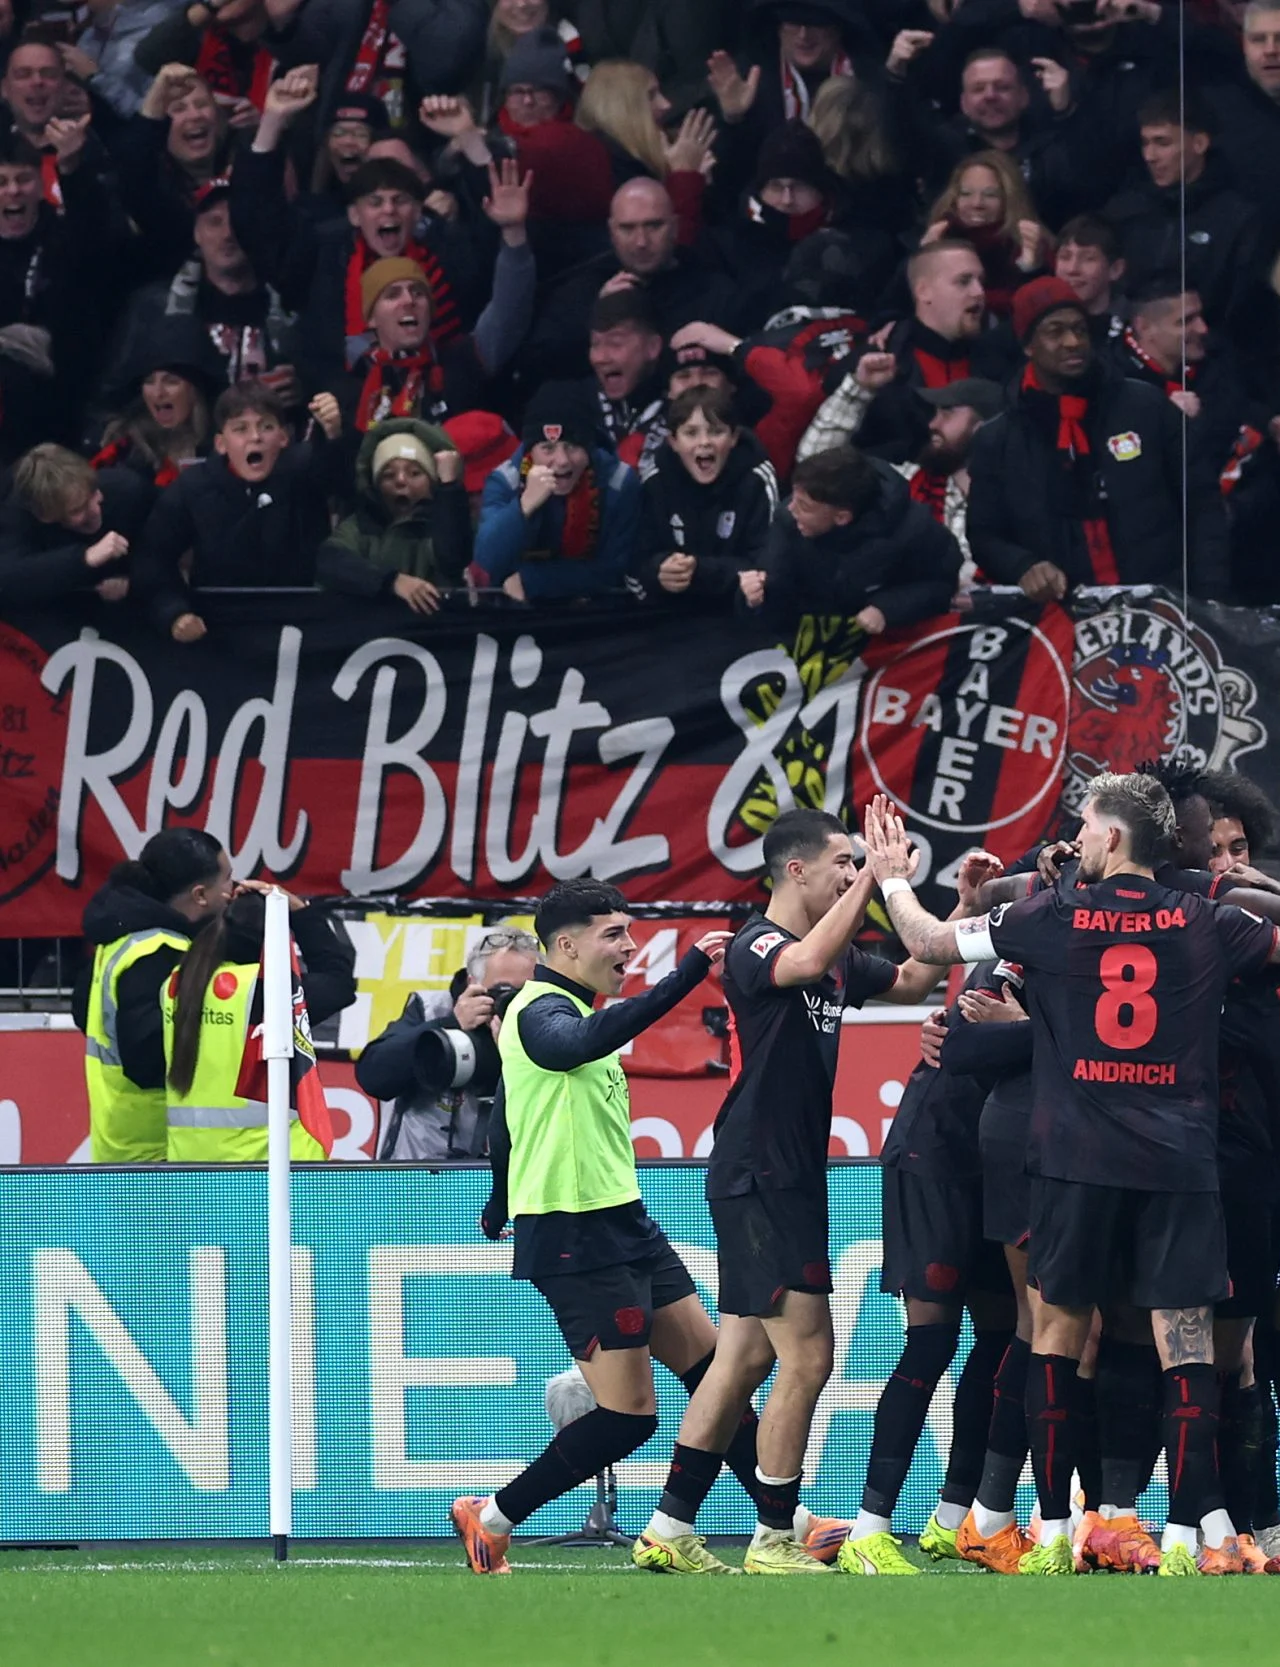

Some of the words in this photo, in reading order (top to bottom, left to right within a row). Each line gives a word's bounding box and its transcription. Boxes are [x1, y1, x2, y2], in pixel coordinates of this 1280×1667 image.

[1073, 612, 1218, 715] ERLANDS
[40, 625, 308, 882] Red
[331, 633, 675, 897] Blitz
[706, 647, 869, 873] 81
[871, 685, 1059, 760] BAYER
[927, 624, 1008, 822] BAYER
[1072, 908, 1152, 934] BAYER
[1155, 906, 1188, 931] 04
[1094, 942, 1158, 1051] 8
[1073, 1058, 1178, 1085] ANDRICH
